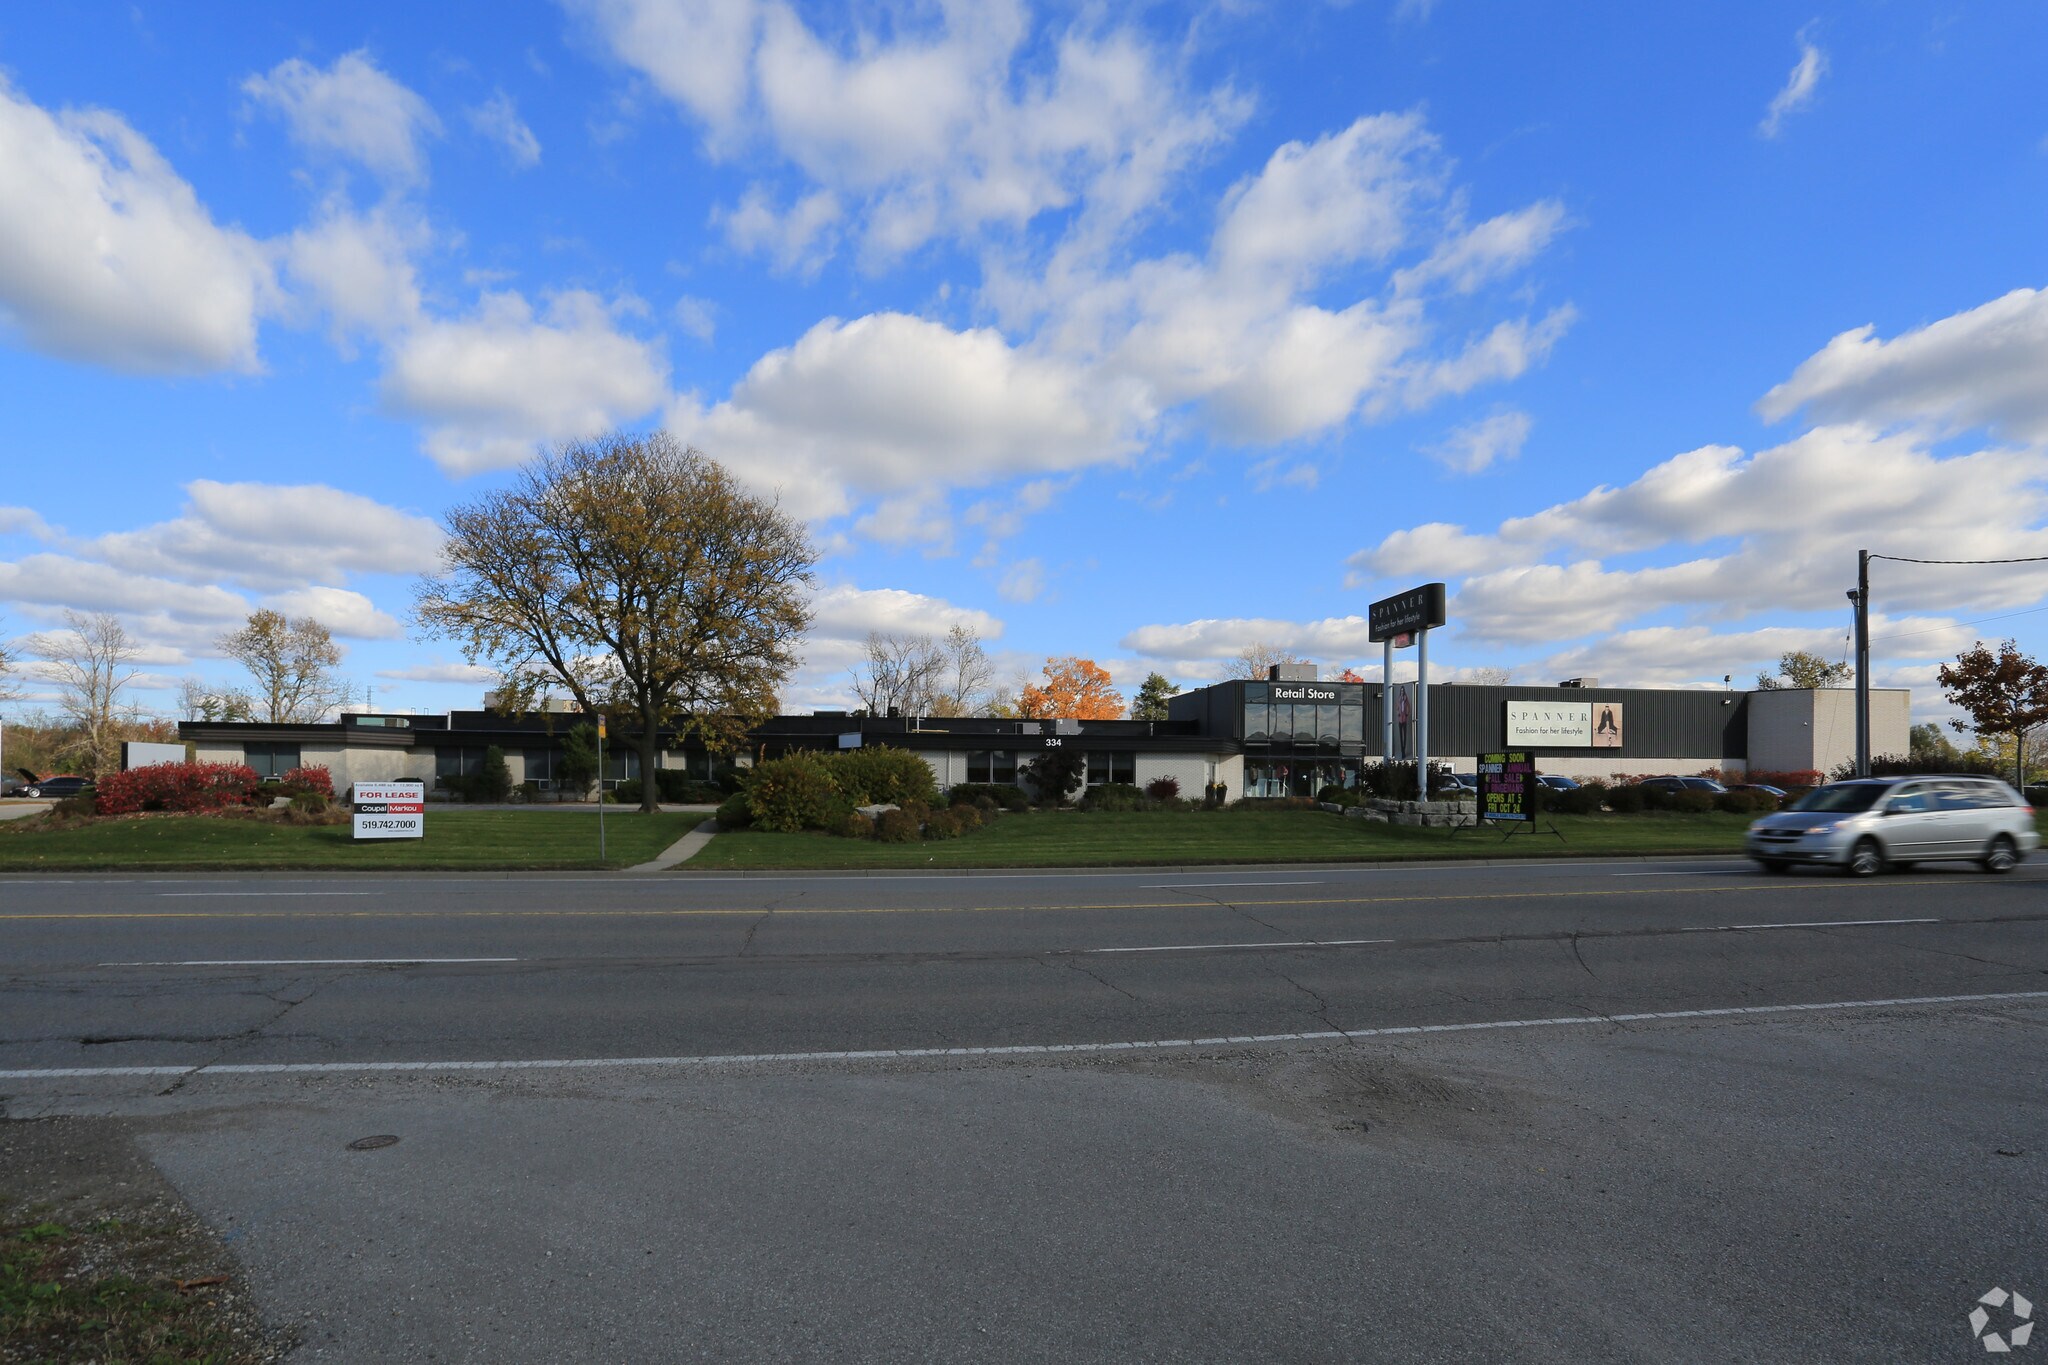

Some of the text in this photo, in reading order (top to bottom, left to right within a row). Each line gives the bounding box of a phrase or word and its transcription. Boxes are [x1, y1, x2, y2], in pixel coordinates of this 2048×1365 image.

[1372, 594, 1423, 618] SPANNER
[1275, 687, 1335, 699] Retail Store
[1511, 712, 1588, 721] SPANNER
[1550, 727, 1560, 735] her
[1561, 727, 1583, 736] lifestyle
[1045, 738, 1062, 747] 334
[1484, 753, 1525, 763] COMING SOON
[1479, 763, 1503, 773] SPANNER
[360, 791, 419, 799] FOR LEASE
[1486, 793, 1505, 803] OPENS
[1507, 793, 1515, 803] AT
[361, 805, 387, 813] Coupal
[1487, 803, 1521, 813] FRI OCT 24
[362, 820, 416, 830] 519.742.7000
